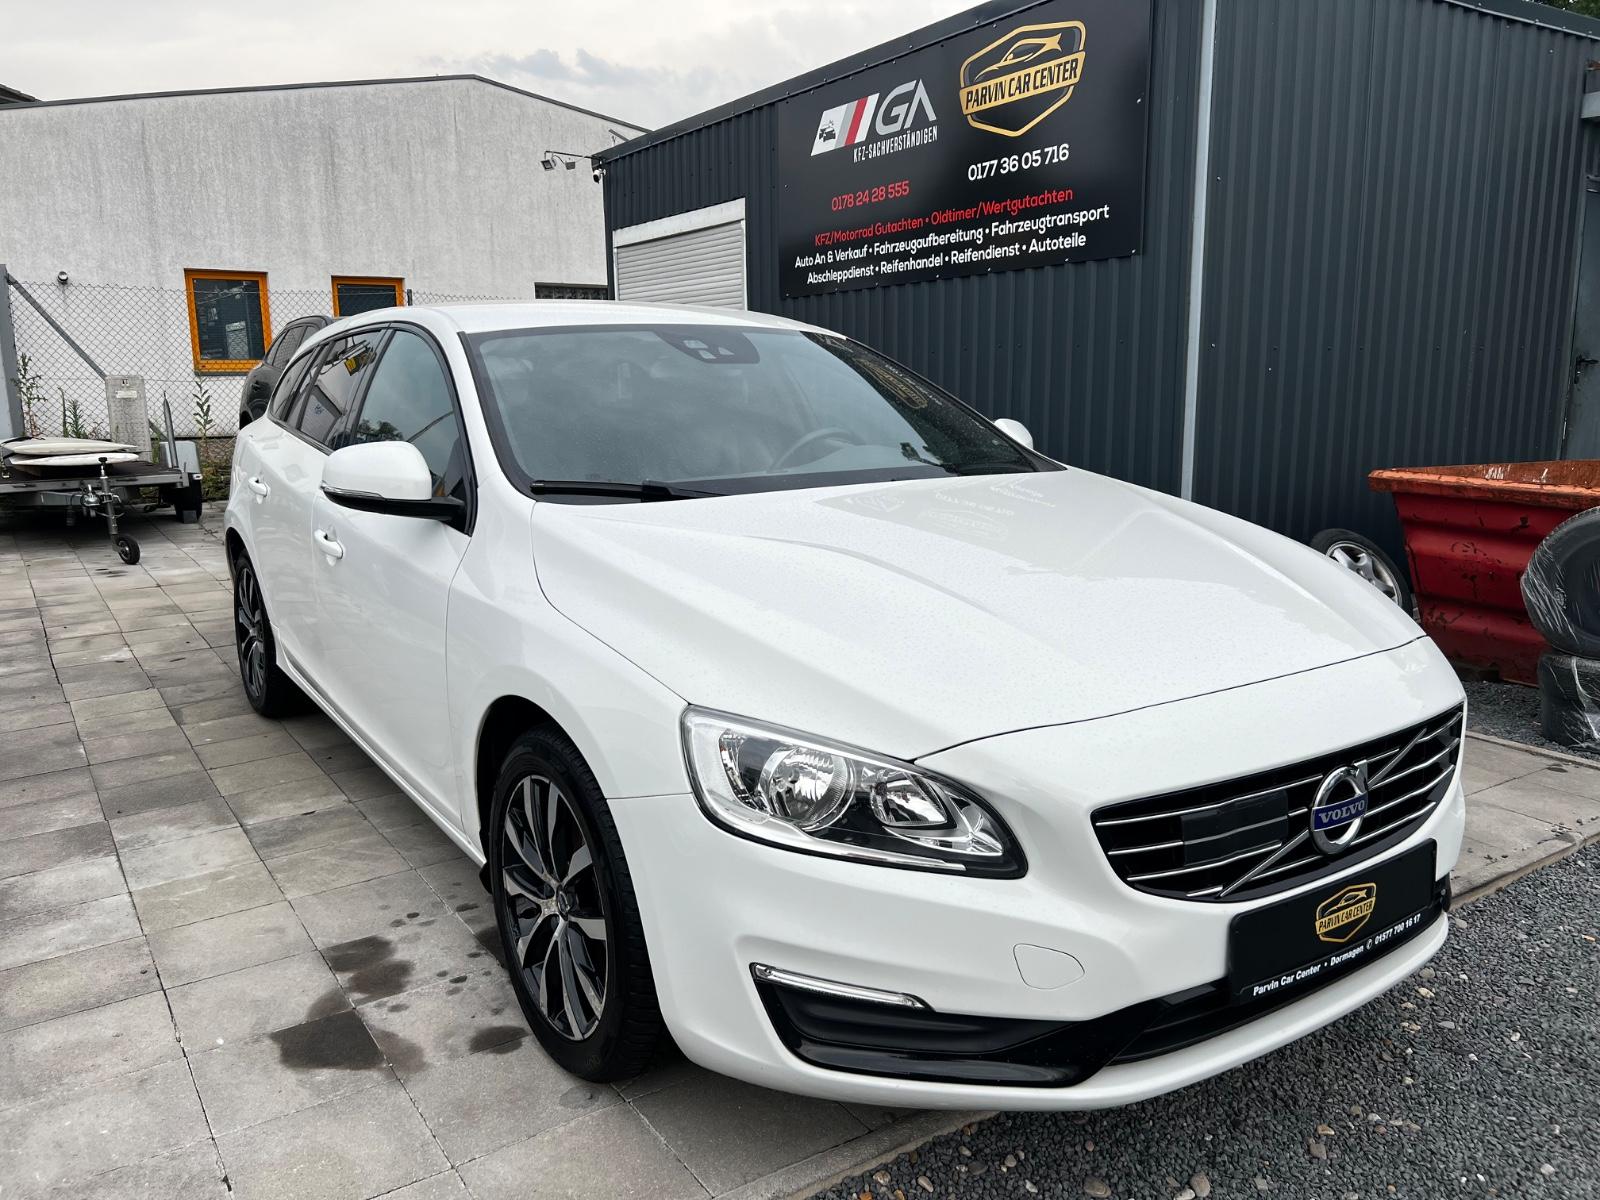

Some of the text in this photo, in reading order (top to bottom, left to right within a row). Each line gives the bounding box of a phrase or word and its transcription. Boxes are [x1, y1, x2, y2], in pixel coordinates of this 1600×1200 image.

[965, 58, 1079, 110] PARVIN CAR CENTER
[853, 126, 938, 163] KFZ-SACHVERSTÄNDIGEN
[967, 143, 1069, 181] 0177 36 05 716
[815, 187, 1073, 247] KFZ/Motorrad Gutachten Oldtimer/Wertgutachten
[832, 180, 910, 211] 0178 24 28 555
[795, 204, 1109, 268] Auto An & Verkauf Fahrzeugaufbereitung Fahrzeugtransport
[807, 232, 1087, 284] Abschleppdienst Reifenhandel Reifendienst Autoteile
[1318, 799, 1366, 824] VOLVO
[1318, 900, 1373, 932] PARVIN CAR CENTER
[1253, 913, 1421, 996] Parvin Car Center Dormagen 01577 700 16 17
